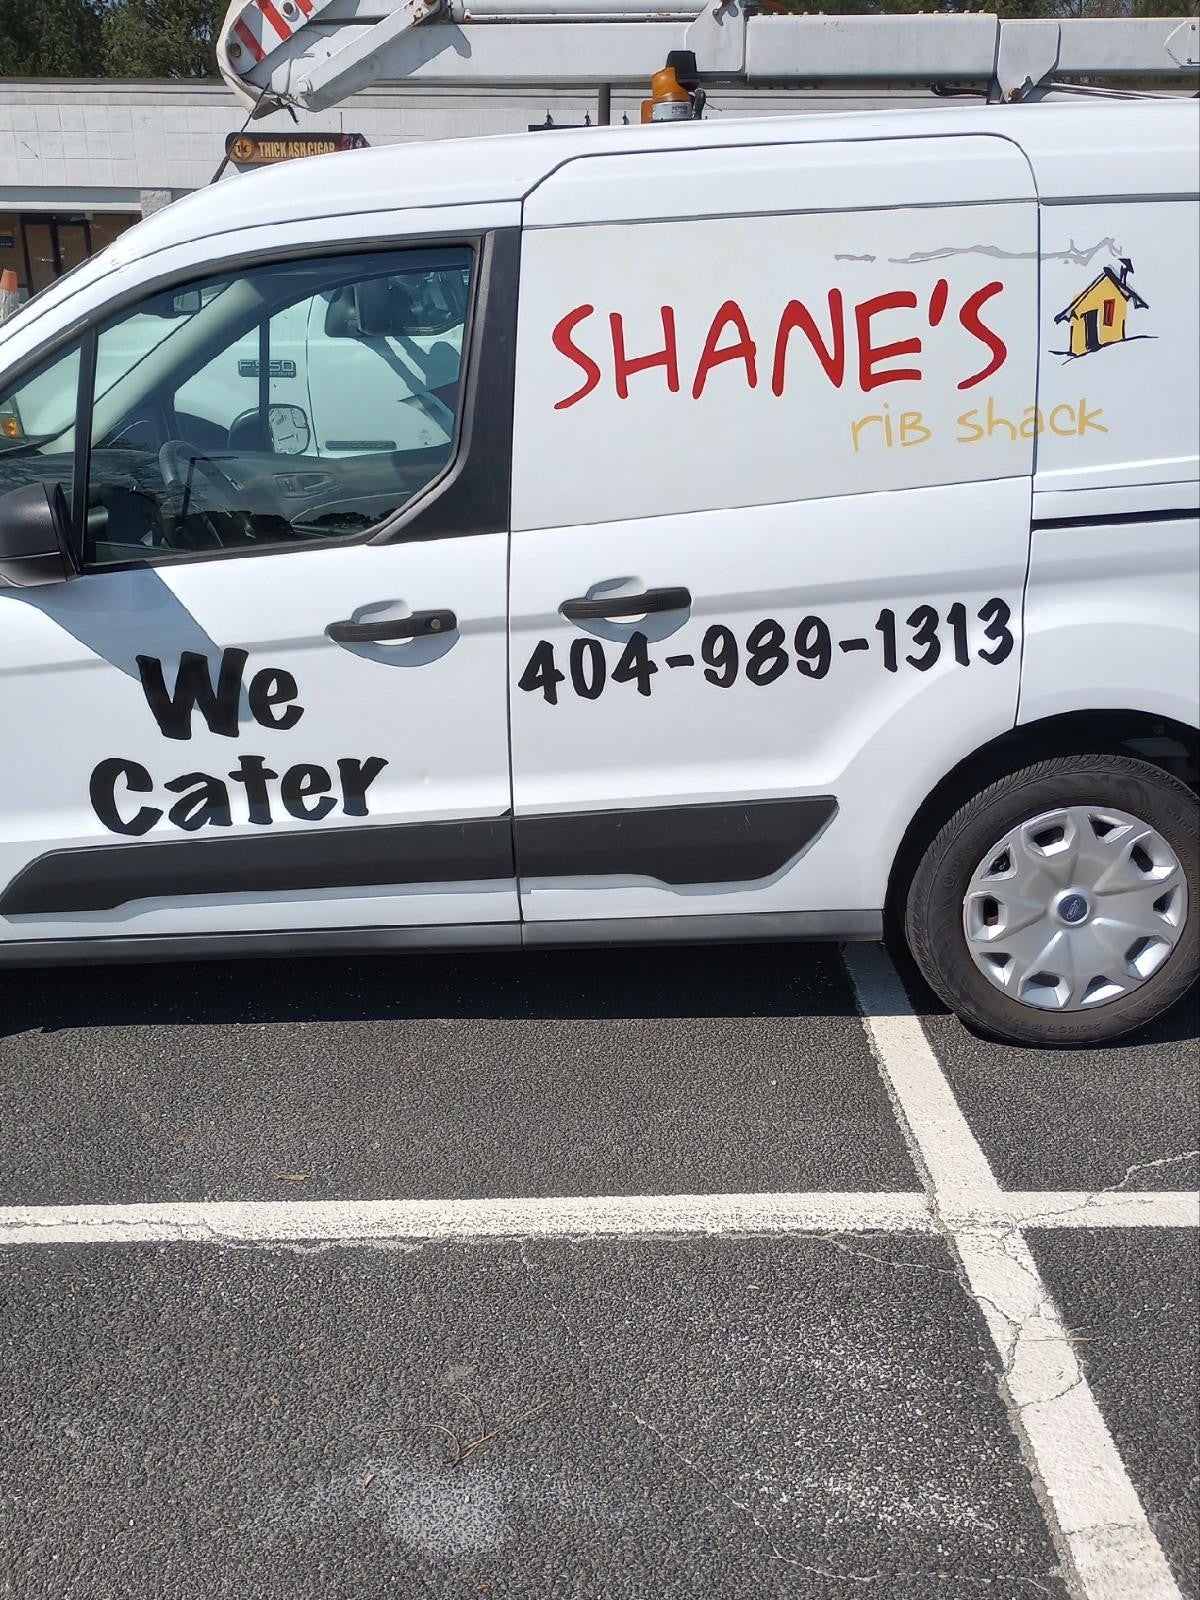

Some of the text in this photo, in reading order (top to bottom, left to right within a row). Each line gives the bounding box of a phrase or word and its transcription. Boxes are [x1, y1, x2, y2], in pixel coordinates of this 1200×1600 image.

[258, 142, 287, 158] THICK
[288, 142, 307, 158] ASH
[553, 280, 1008, 410] SHANE'S
[956, 397, 1109, 443] shack
[136, 647, 304, 741] We
[517, 597, 1014, 706] 404-989-1313
[90, 755, 389, 836] Cater
